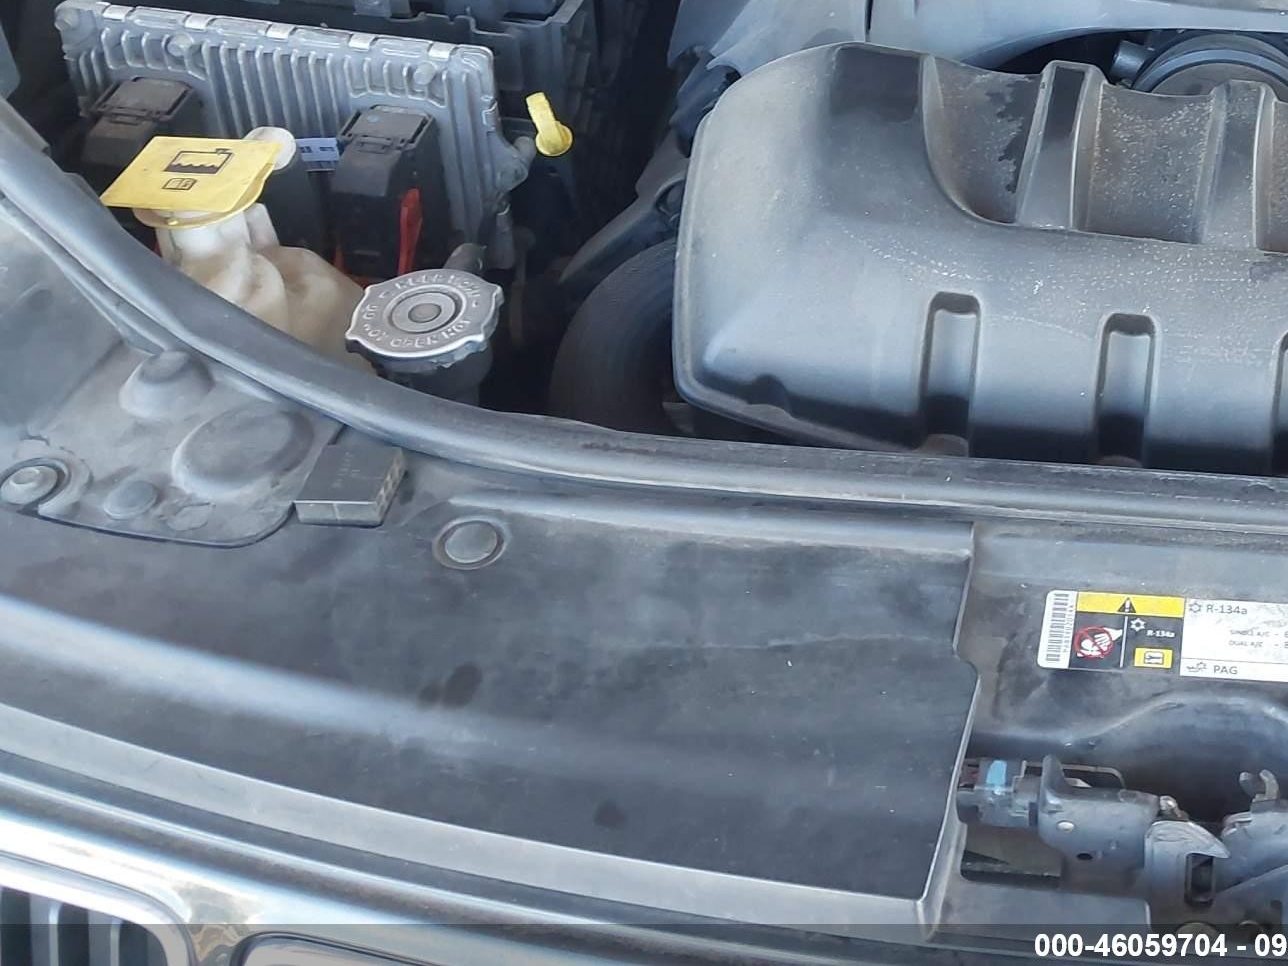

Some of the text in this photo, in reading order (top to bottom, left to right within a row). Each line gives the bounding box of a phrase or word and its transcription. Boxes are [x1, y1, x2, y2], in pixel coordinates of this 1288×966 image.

[1206, 604, 1248, 615] R-134a
[1146, 629, 1176, 638] R-134a
[1213, 665, 1238, 675] PAG
